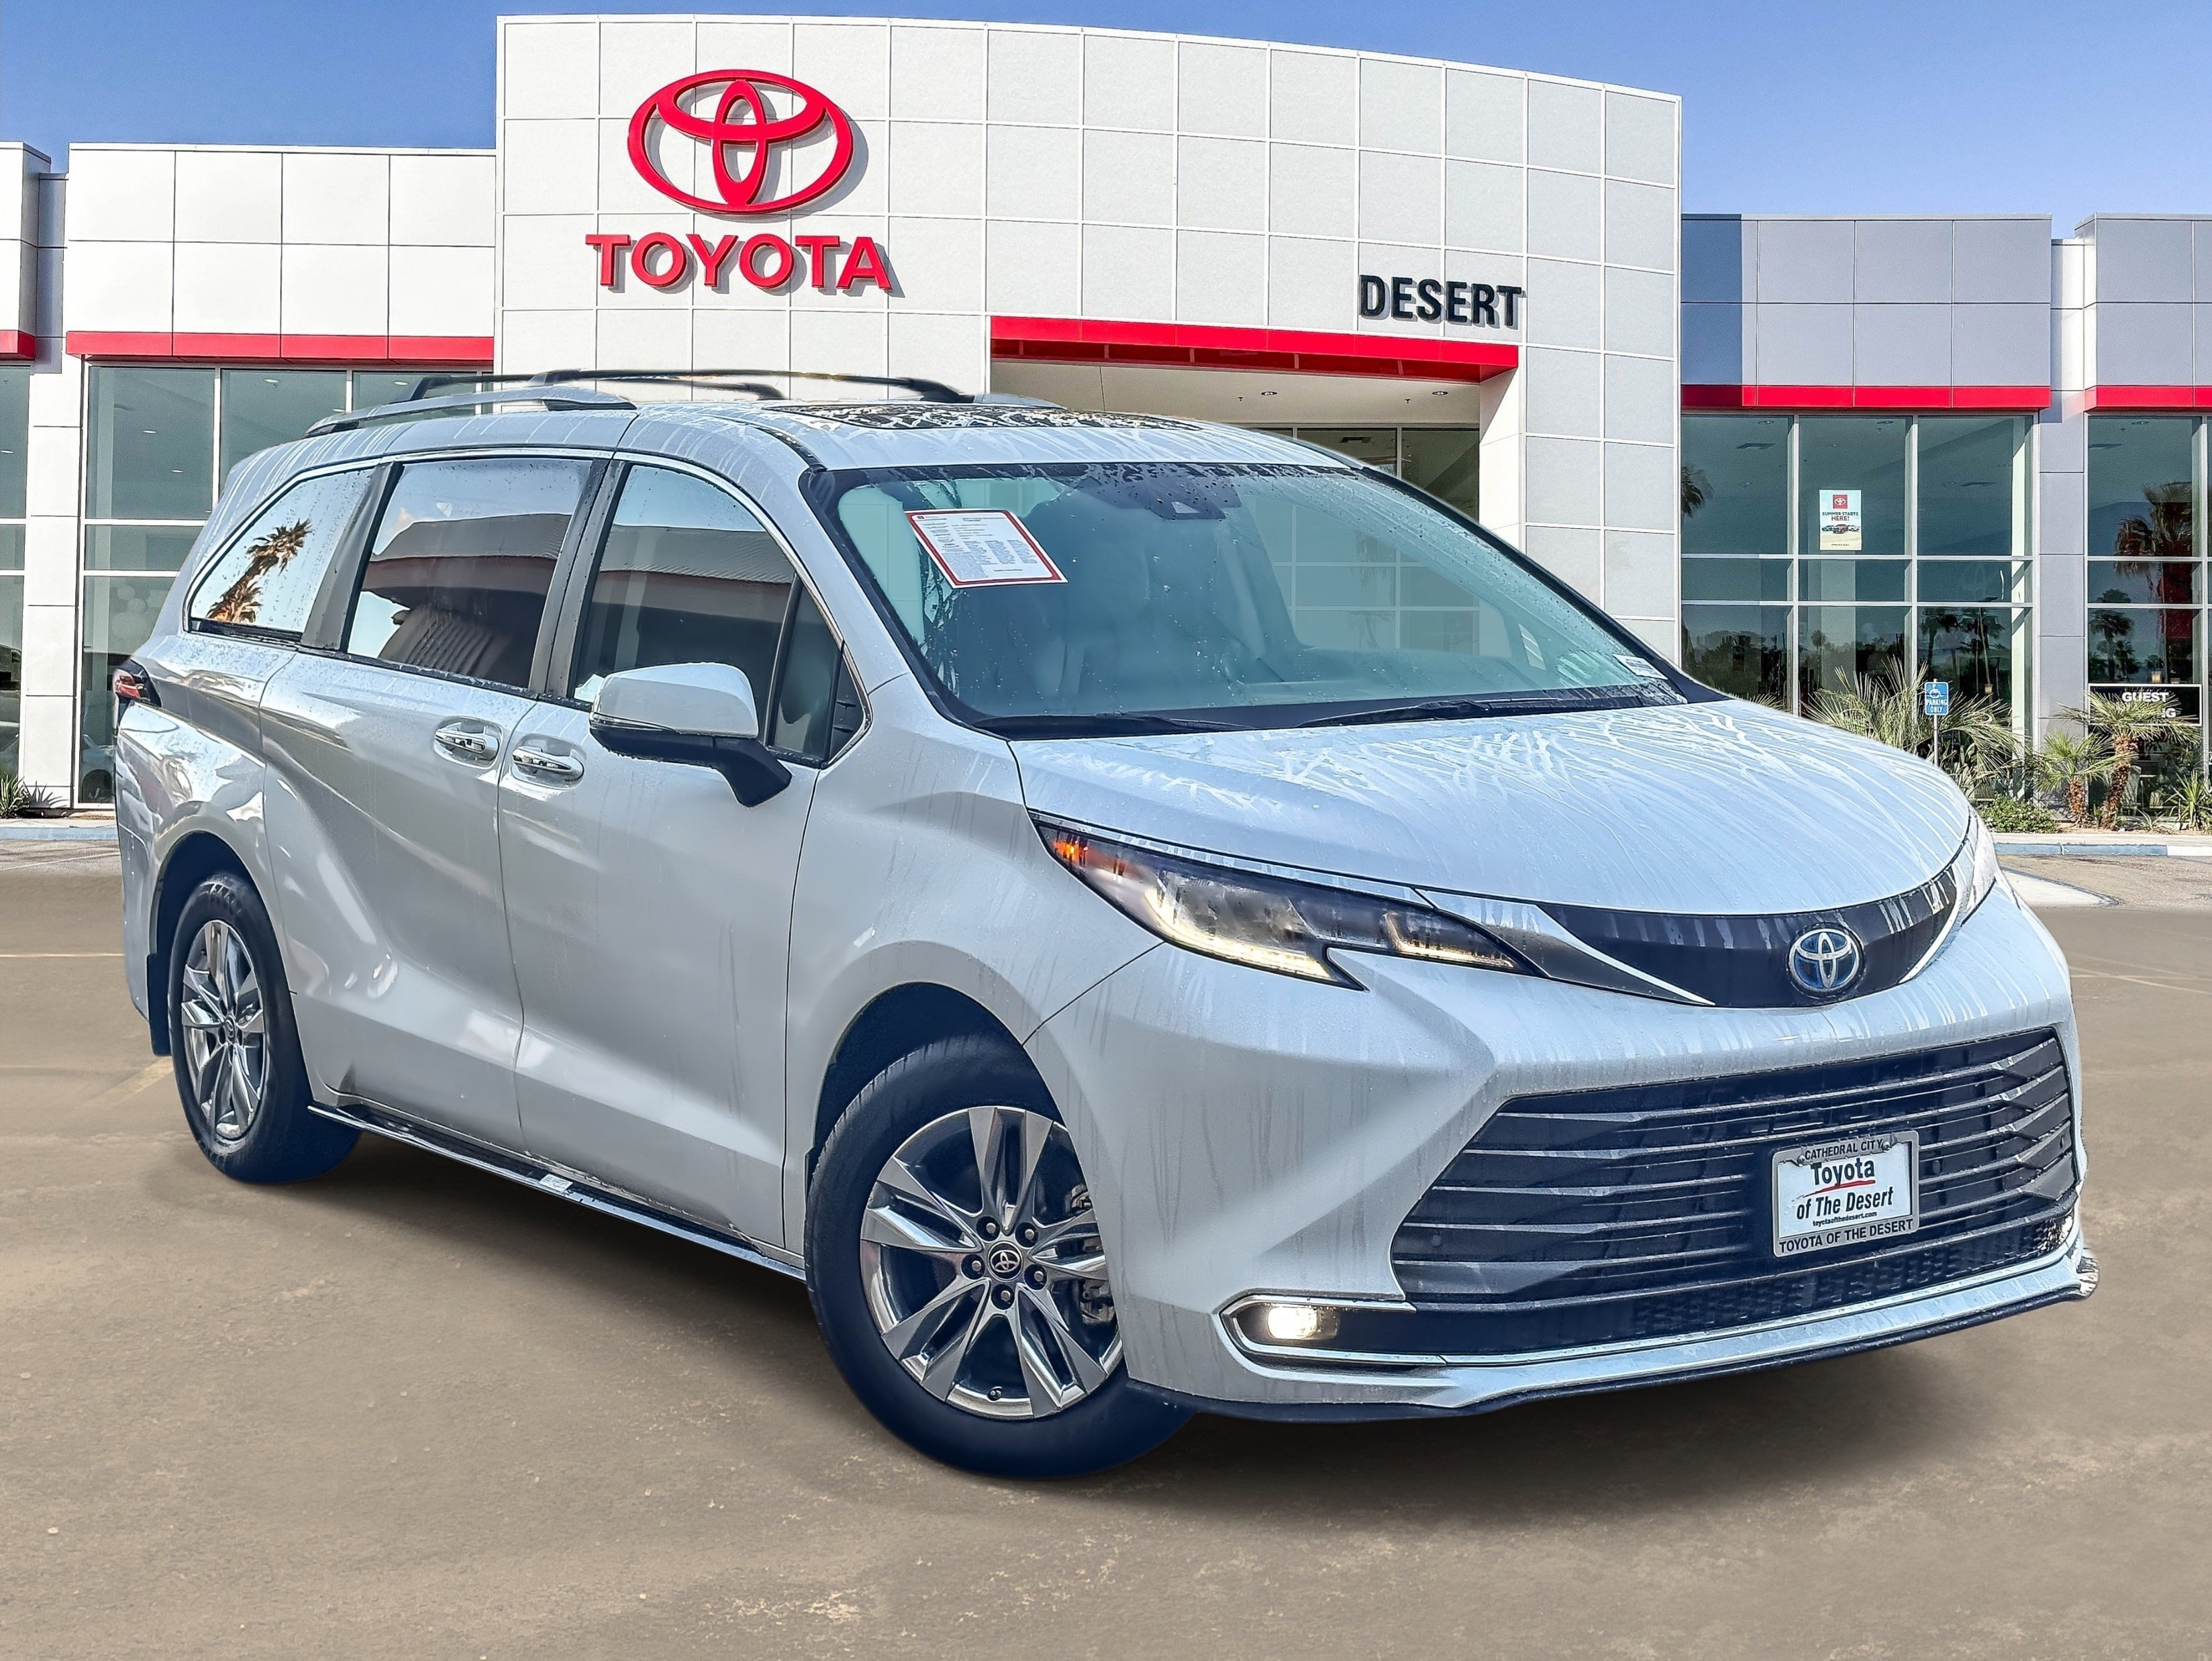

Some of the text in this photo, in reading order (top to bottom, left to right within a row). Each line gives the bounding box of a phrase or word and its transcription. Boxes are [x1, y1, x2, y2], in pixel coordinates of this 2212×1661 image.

[586, 233, 892, 289] TOYOTA
[1360, 274, 1522, 327] DESERT
[2121, 692, 2169, 702] GUEST
[1805, 1139, 1883, 1160] CATHEDRAL CITY
[1811, 1158, 1875, 1186] Toyota
[1797, 1187, 1894, 1220] of The Desert
[1779, 1219, 1913, 1253] TOYOTA OF THE DESERT
